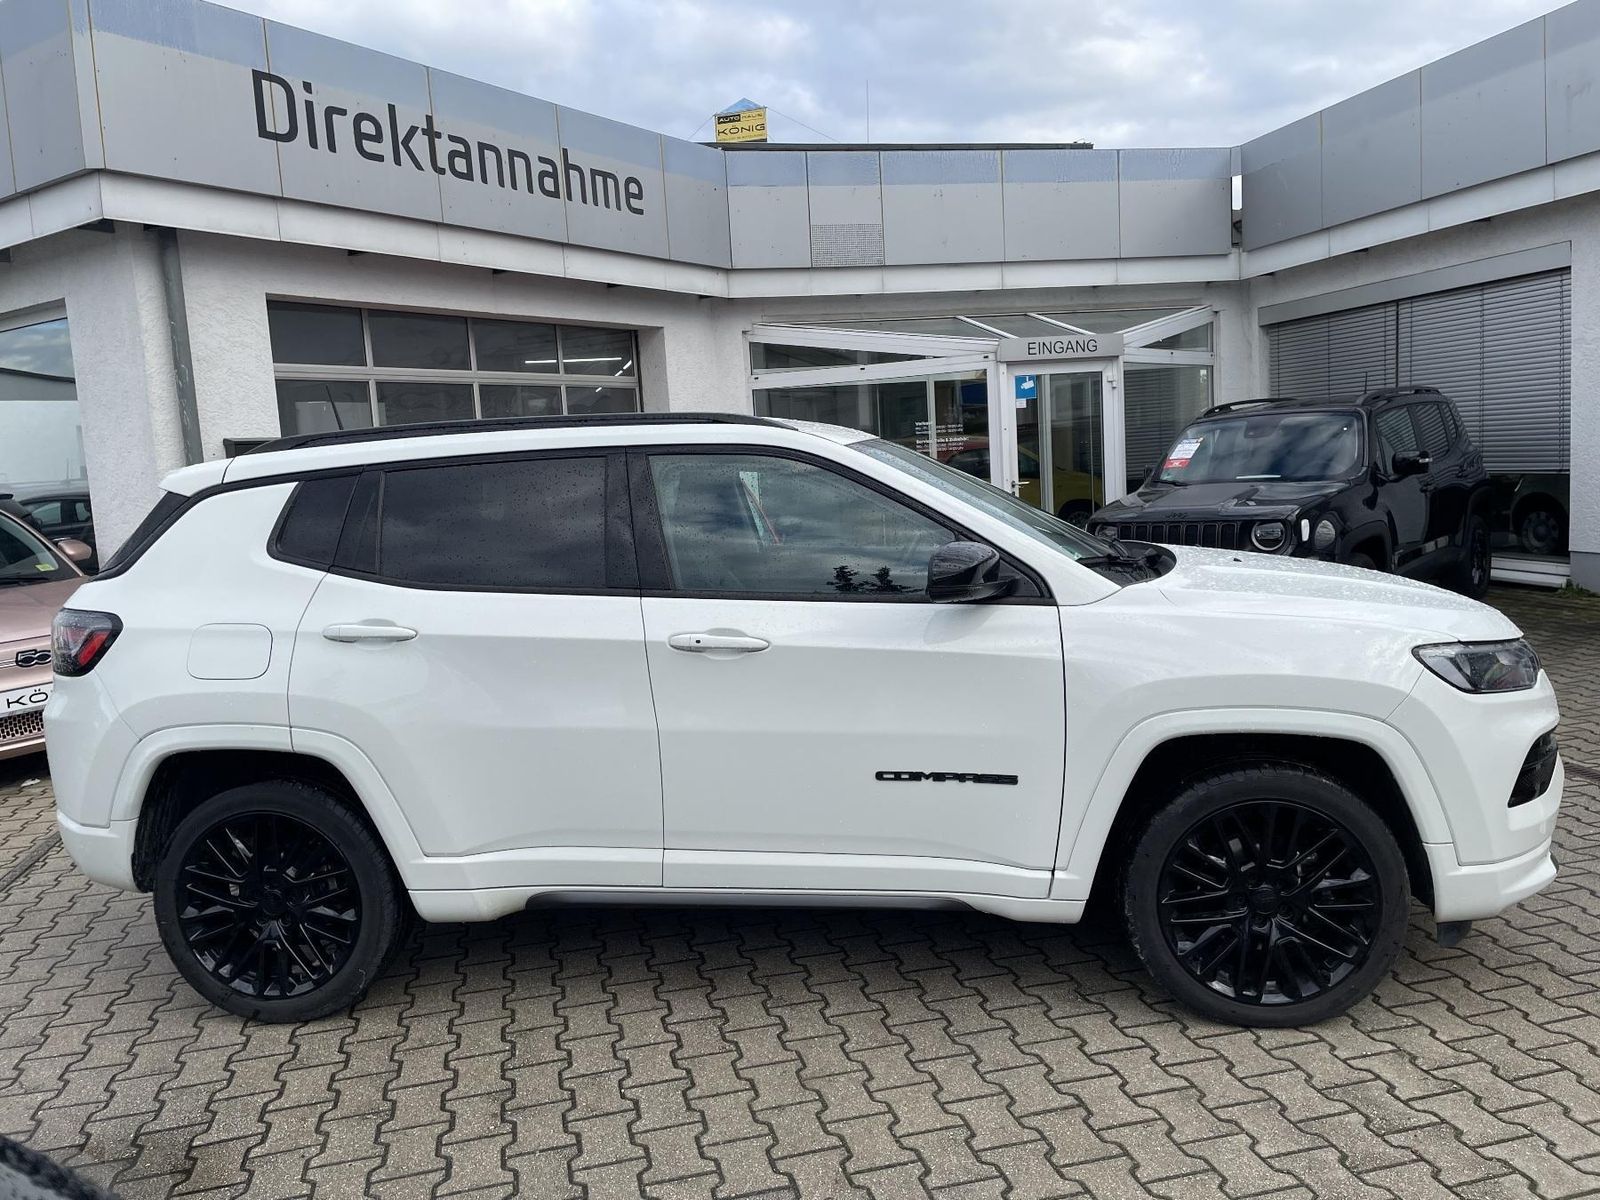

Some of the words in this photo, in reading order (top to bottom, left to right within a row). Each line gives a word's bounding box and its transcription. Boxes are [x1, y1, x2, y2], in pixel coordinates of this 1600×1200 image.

[717, 123, 766, 136] KÖNIG
[252, 68, 644, 216] Direktannahme
[1027, 339, 1098, 355] EINGANG
[6, 688, 49, 709] KÖ
[875, 771, 1018, 785] COMPASS
